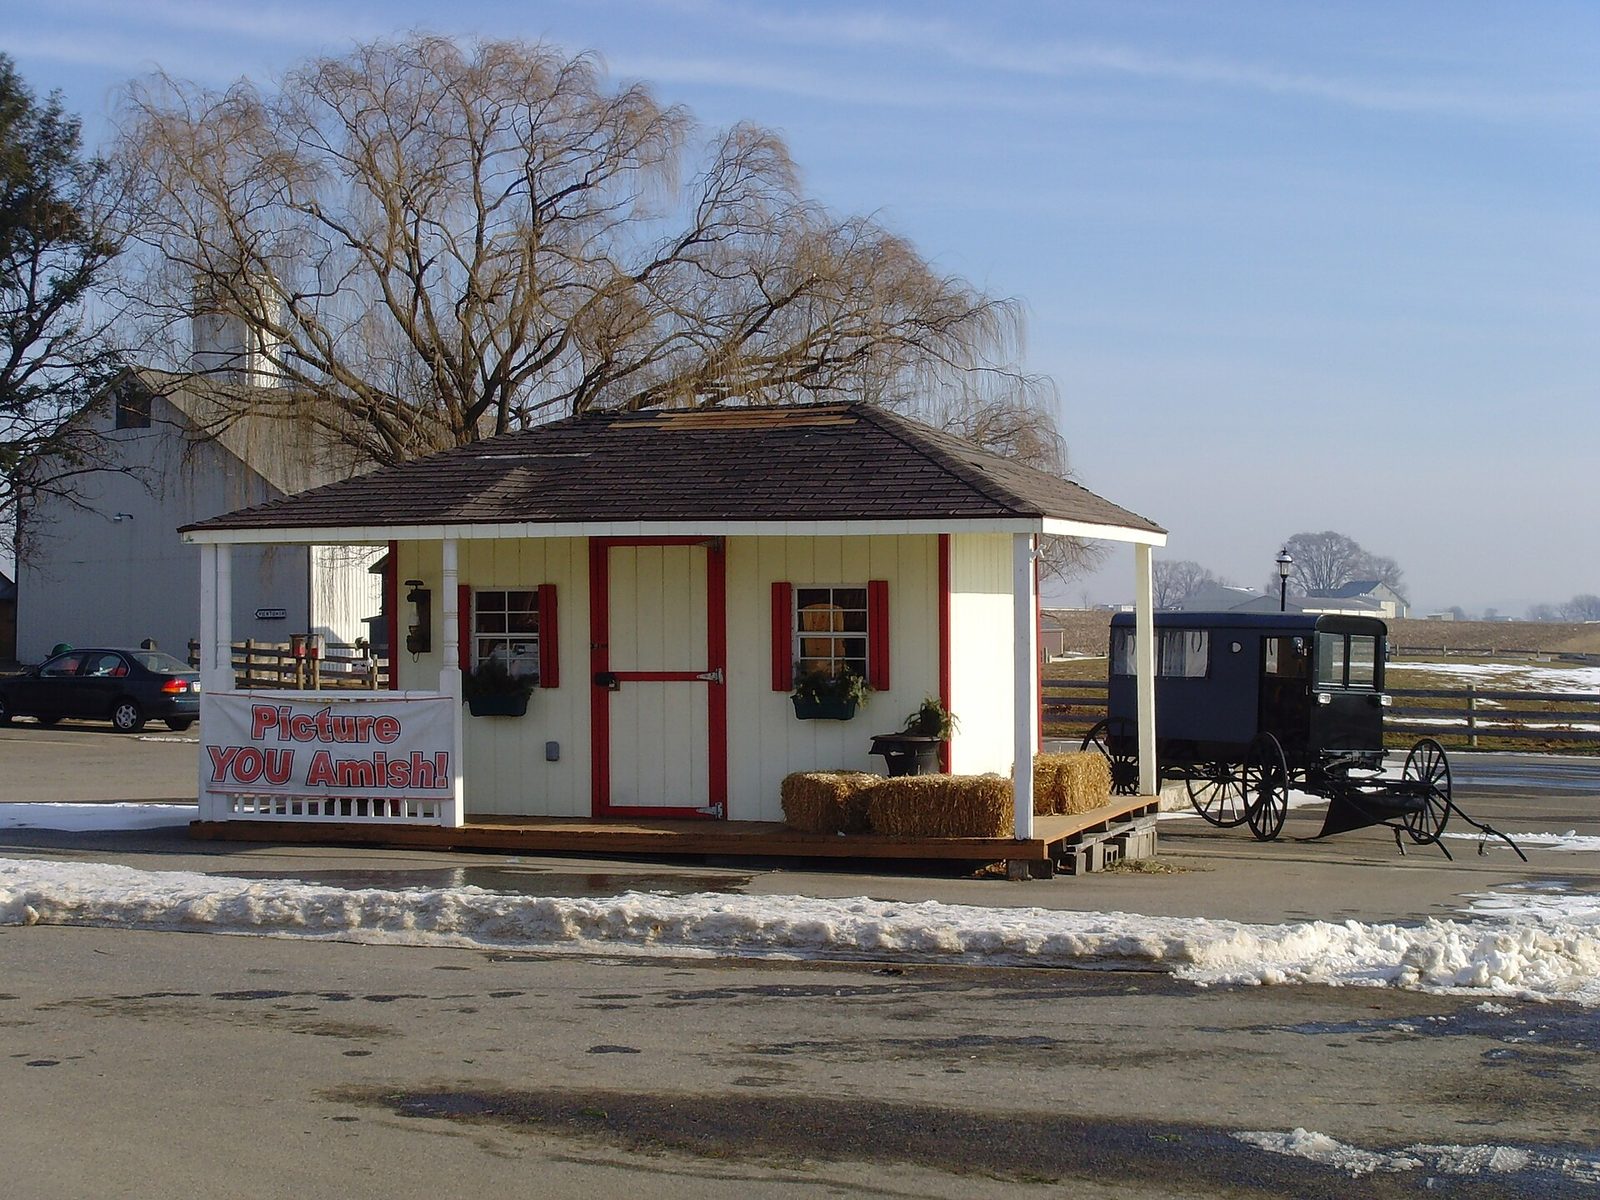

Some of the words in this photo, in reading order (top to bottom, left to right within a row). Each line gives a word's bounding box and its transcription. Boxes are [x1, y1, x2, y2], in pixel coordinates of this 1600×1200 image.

[252, 704, 401, 743] Picture
[207, 746, 295, 785] YOU
[306, 750, 449, 789] Amish!
